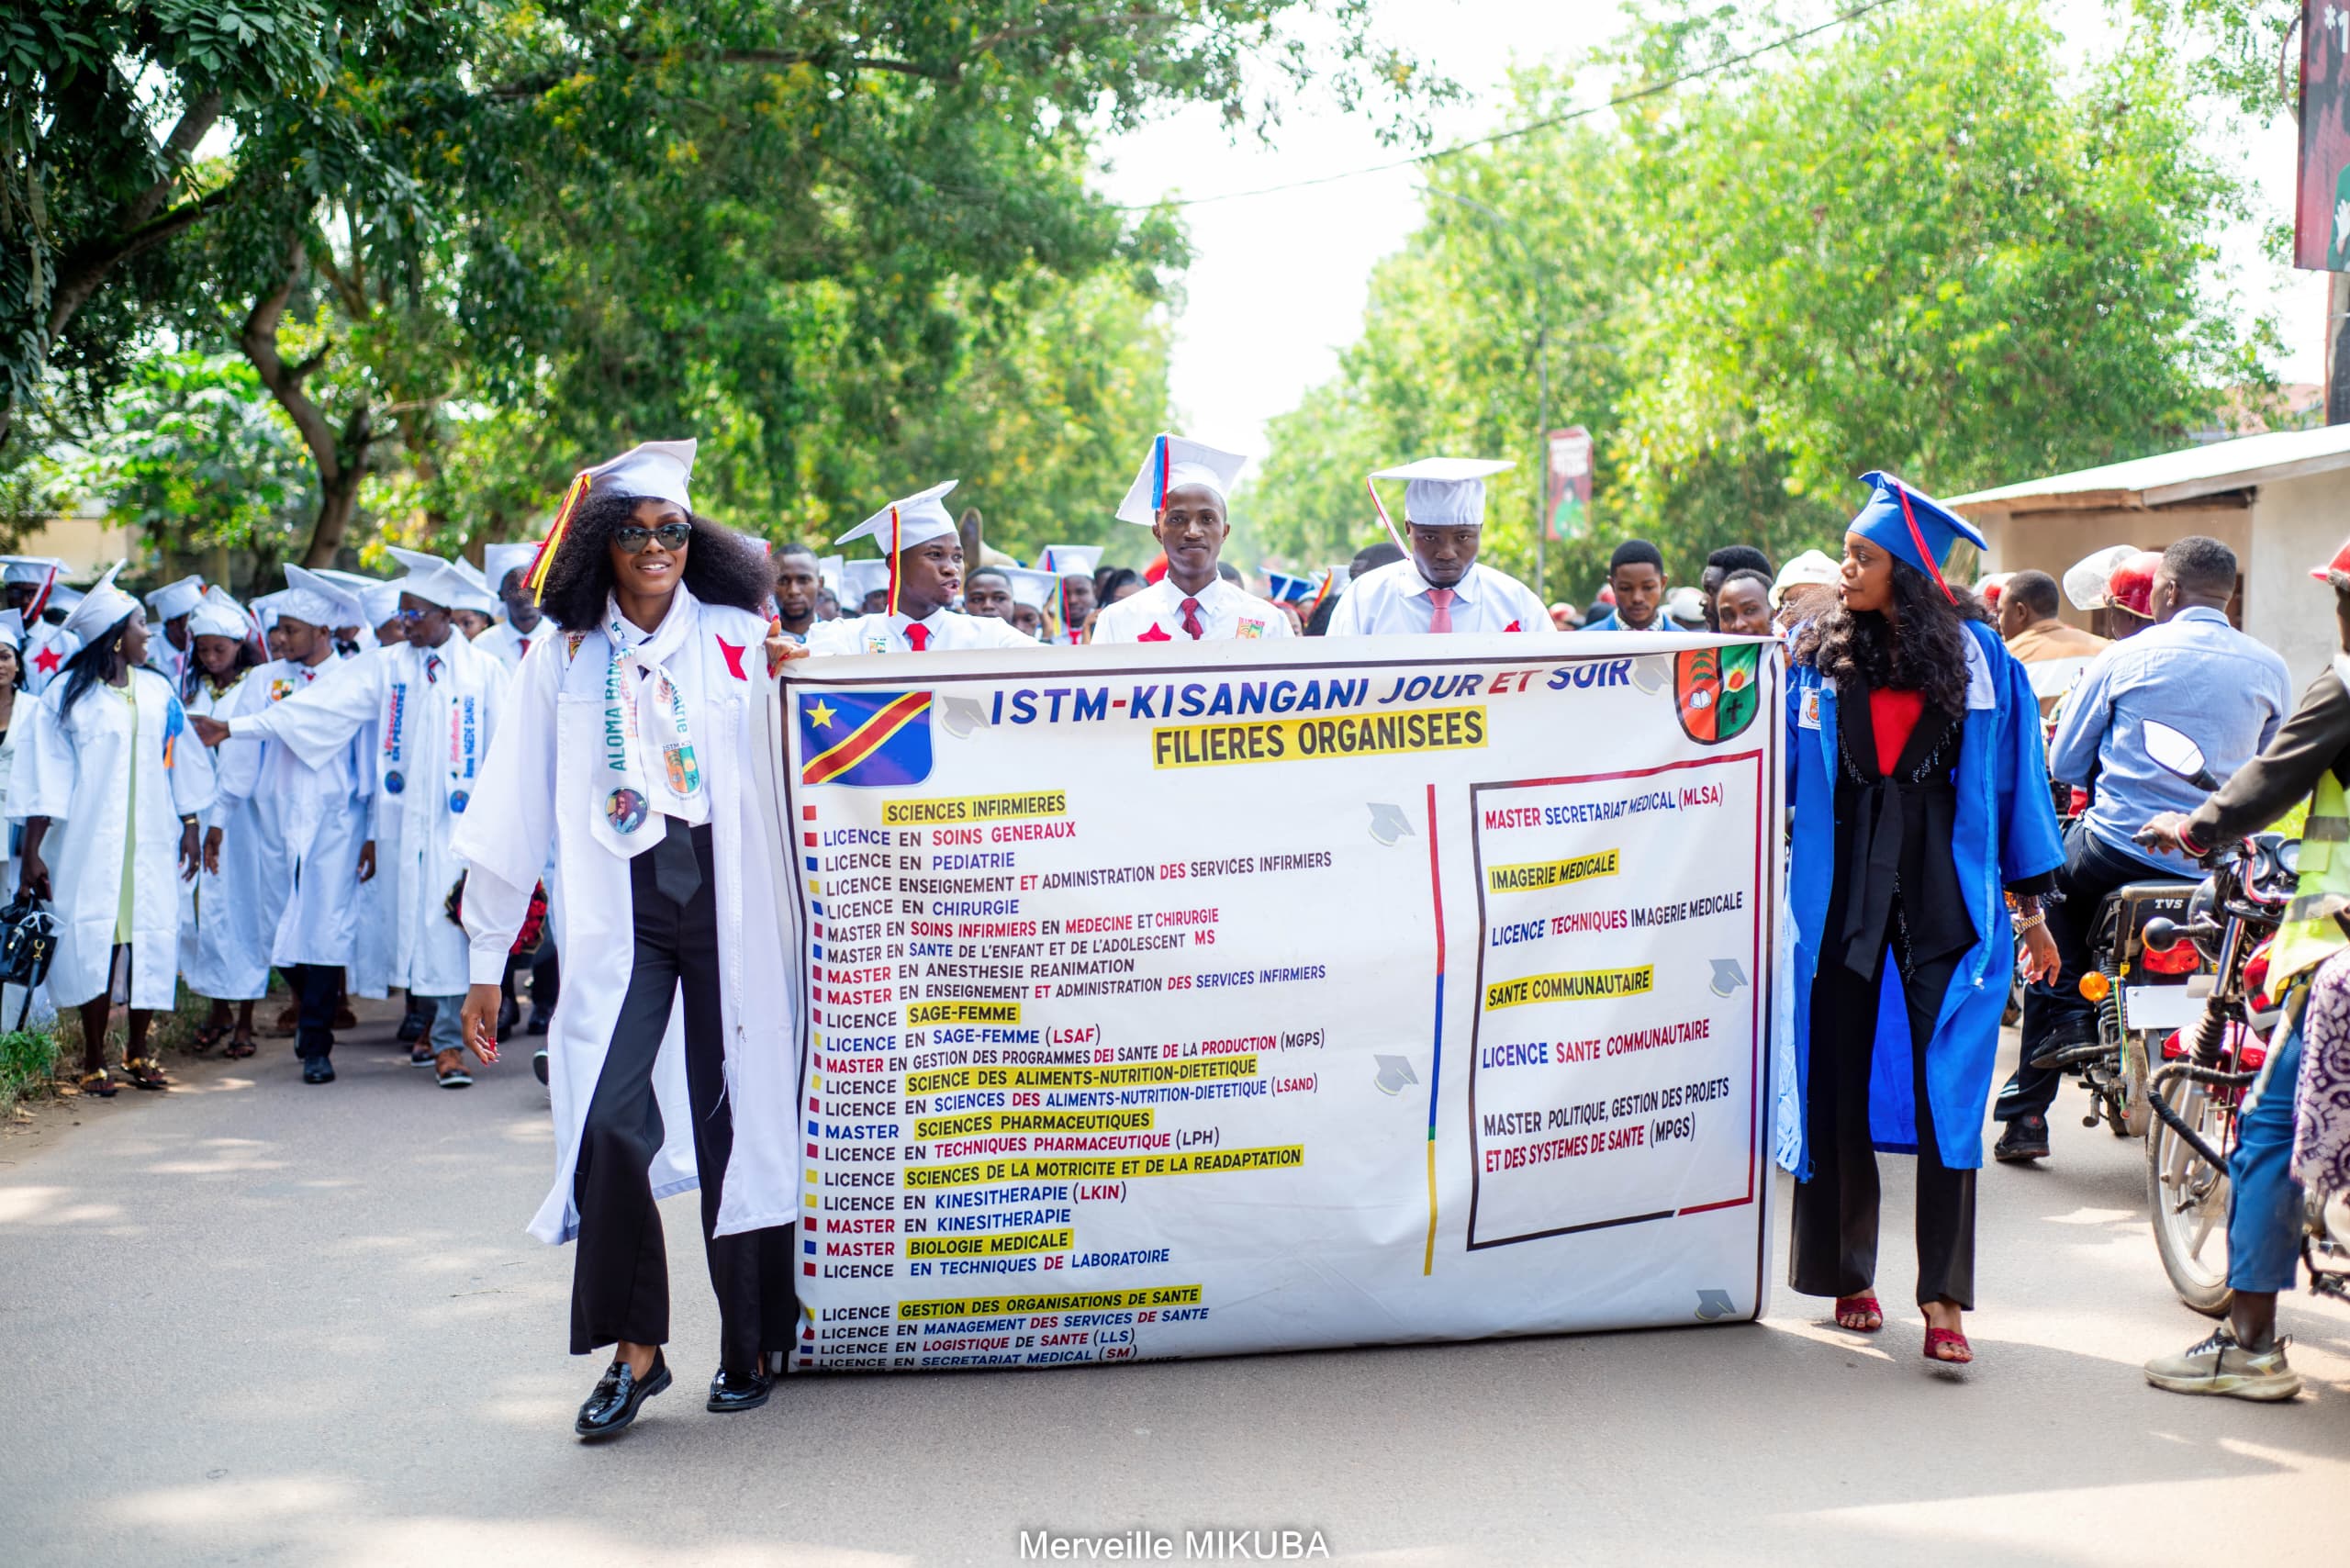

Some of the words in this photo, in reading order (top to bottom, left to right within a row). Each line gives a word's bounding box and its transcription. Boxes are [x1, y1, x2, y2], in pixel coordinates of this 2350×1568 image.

[991, 678, 1369, 725] ISTM-KISANGANI
[1378, 674, 1483, 704] JOUR
[1488, 669, 1542, 694] ET
[1547, 659, 1632, 689] SOIR
[605, 707, 627, 771] ALOMA
[1156, 722, 1284, 766] FILIERES
[1297, 710, 1483, 756] ORGANISEES
[888, 801, 966, 823] SCIENCES
[973, 796, 1066, 817] INFIRMIERES
[1485, 807, 1541, 830] MASTER
[1546, 801, 1627, 825] SECRETARIAT
[1628, 793, 1675, 813] MEDICAL
[1679, 782, 1723, 811] (MLSA)
[823, 830, 890, 847] LICENCE
[900, 832, 921, 847] EN
[933, 828, 983, 846] SOINS
[991, 822, 1076, 843] GENERAUX
[826, 855, 891, 872] LICENCE
[900, 855, 921, 870] EN
[933, 853, 1015, 870] PEDIATRIE
[826, 878, 891, 897] LICENCE
[900, 877, 1014, 894] ENSEIGNEMENT
[1021, 875, 1038, 890] ET
[1043, 867, 1155, 890] ADMINISTRATION
[1160, 863, 1186, 880] DES
[1191, 857, 1254, 878] SERVICES
[1259, 852, 1331, 871] INFIRMIERS
[1491, 862, 1555, 889] IMAGERIE
[1560, 855, 1616, 881] MEDICALE
[827, 900, 893, 920] LICENCE
[902, 901, 923, 916] EN
[933, 900, 1019, 916] CHIRURGIE
[1492, 919, 1545, 946] LICENCE
[1551, 910, 1628, 935] TECHNIQUES
[1631, 903, 1686, 926] IMAGERIE
[1689, 891, 1743, 917] MEDICALE
[2154, 899, 2184, 909] TVS
[828, 945, 882, 965] MASTER
[887, 944, 905, 958] EN
[910, 942, 953, 958] SANTE
[958, 942, 976, 958] DE
[981, 939, 1045, 958] L'ENFANT
[1049, 938, 1065, 954] ET
[1070, 937, 1089, 954] DE
[1093, 933, 1185, 953] L'ADOLESCENT
[1195, 930, 1215, 946] MS
[828, 968, 891, 985] MASTER
[899, 965, 918, 980] EN
[926, 961, 1024, 980] ANESTHESIE
[1030, 958, 1134, 978] REANIMATION
[828, 989, 891, 1005] MASTER
[900, 985, 919, 1000] EN
[926, 984, 1028, 1000] ENSEIGNEMENT
[1035, 983, 1050, 999] ET
[1056, 978, 1162, 998] ADMINISTRATION
[1168, 975, 1192, 991] DES
[1196, 970, 1255, 989] SERVICES
[1259, 965, 1326, 984] INFIRMIERS
[1488, 987, 1528, 1007] SANTE
[1532, 969, 1650, 998] COMMUNAUTAIRE
[826, 1012, 896, 1028] LICENCE
[910, 1006, 1016, 1023] SAGE-FEMME
[826, 1036, 895, 1051] LICENCE
[905, 1032, 925, 1047] EN
[933, 1028, 1039, 1045] SAGE-FEMME
[1046, 1026, 1101, 1047] (LSAF)
[826, 1058, 883, 1073] MASTER
[890, 1055, 907, 1070] EN
[913, 1050, 968, 1070] GESTION
[972, 1049, 997, 1065] DES
[1002, 1047, 1091, 1065] PROGRAMMES
[1117, 1044, 1158, 1061] SANTE
[1162, 1043, 1179, 1058] DE
[1181, 1041, 1198, 1057] LA
[1202, 1036, 1276, 1056] PRODUCTION
[1281, 1029, 1325, 1052] (MGPS)
[1483, 1043, 1549, 1069] LICENCE
[1556, 1039, 1600, 1063] SANTE
[1606, 1019, 1709, 1057] COMMUNAUTAIRE
[825, 1079, 896, 1094] LICENCE
[908, 1072, 969, 1092] SCIENCE
[978, 1070, 1006, 1086] DES
[1015, 1058, 1256, 1085] ALIMENTS-NUTRITION-DIETETIQUE
[825, 1101, 895, 1116] LICENCE
[905, 1098, 926, 1114] EN
[934, 1094, 1004, 1112] SCIENCES
[1012, 1092, 1041, 1108] DES
[1046, 1080, 1266, 1107] ALIMENTS-NUTRITION-DIETETIQUE
[1271, 1074, 1318, 1098] (LSAND)
[1484, 1111, 1541, 1137] MASTER
[1548, 1101, 1608, 1131] POLITIQUE,
[1611, 1091, 1658, 1119] GESTION
[1661, 1087, 1683, 1109] DES
[1685, 1077, 1729, 1104] PROJETS
[825, 1124, 899, 1139] MASTER
[918, 1118, 992, 1137] SCIENCES
[1001, 1111, 1149, 1133] PHARMACEUTIQUES
[1485, 1151, 1501, 1172] ET
[1504, 1147, 1526, 1169] DES
[1528, 1137, 1587, 1165] SYSTEMES
[1590, 1133, 1606, 1154] DE
[1608, 1125, 1644, 1150] SANTE
[1650, 1112, 1695, 1148] (MPGS)
[825, 1146, 895, 1162] LICENCE
[905, 1144, 926, 1159] EN
[934, 1138, 1027, 1158] TECHNIQUES
[1034, 1133, 1170, 1153] PHARMACEUTIQUE
[1175, 1128, 1220, 1151] (LPH)
[824, 1171, 895, 1187] LICENCE
[907, 1167, 980, 1185] SCIENCES
[987, 1164, 1006, 1179] DE
[1010, 1162, 1030, 1178] LA
[1035, 1159, 1117, 1177] MOTRICITE
[1122, 1158, 1142, 1173] ET
[1147, 1156, 1165, 1171] DE
[1169, 1154, 1189, 1170] LA
[1193, 1148, 1300, 1169] READAPTATION
[824, 1195, 894, 1211] LICENCE
[903, 1194, 925, 1210] EN
[934, 1186, 1068, 1208] KINESITHERAPIE
[1072, 1183, 1126, 1204] (LKIN)
[826, 1218, 894, 1234] MASTER
[904, 1217, 926, 1232] EN
[937, 1208, 1070, 1231] KINESITHERAPIE
[826, 1241, 894, 1257] MASTER
[910, 1238, 983, 1256] BIOLOGIE
[990, 1232, 1068, 1251] MEDICALE
[824, 1263, 893, 1279] LICENCE
[910, 1261, 932, 1276] EN
[940, 1257, 1036, 1275] TECHNIQUES
[1044, 1256, 1064, 1271] DE
[1071, 1249, 1169, 1269] LABORATOIRE
[822, 1305, 890, 1321] LICENCE
[901, 1300, 965, 1317] GESTION
[971, 1299, 1000, 1314] DES
[1006, 1294, 1122, 1312] ORGANISATIONS
[1128, 1289, 1147, 1305] DE
[1151, 1288, 1198, 1303] SANTE
[822, 1326, 889, 1340] LICENCE
[897, 1324, 918, 1338] EN
[923, 1318, 1024, 1335] MANAGEMENT
[1030, 1315, 1058, 1329] DES
[1064, 1312, 1133, 1327] SERVICES
[1137, 1310, 1157, 1324] DE
[1161, 1308, 1208, 1322] SANTE
